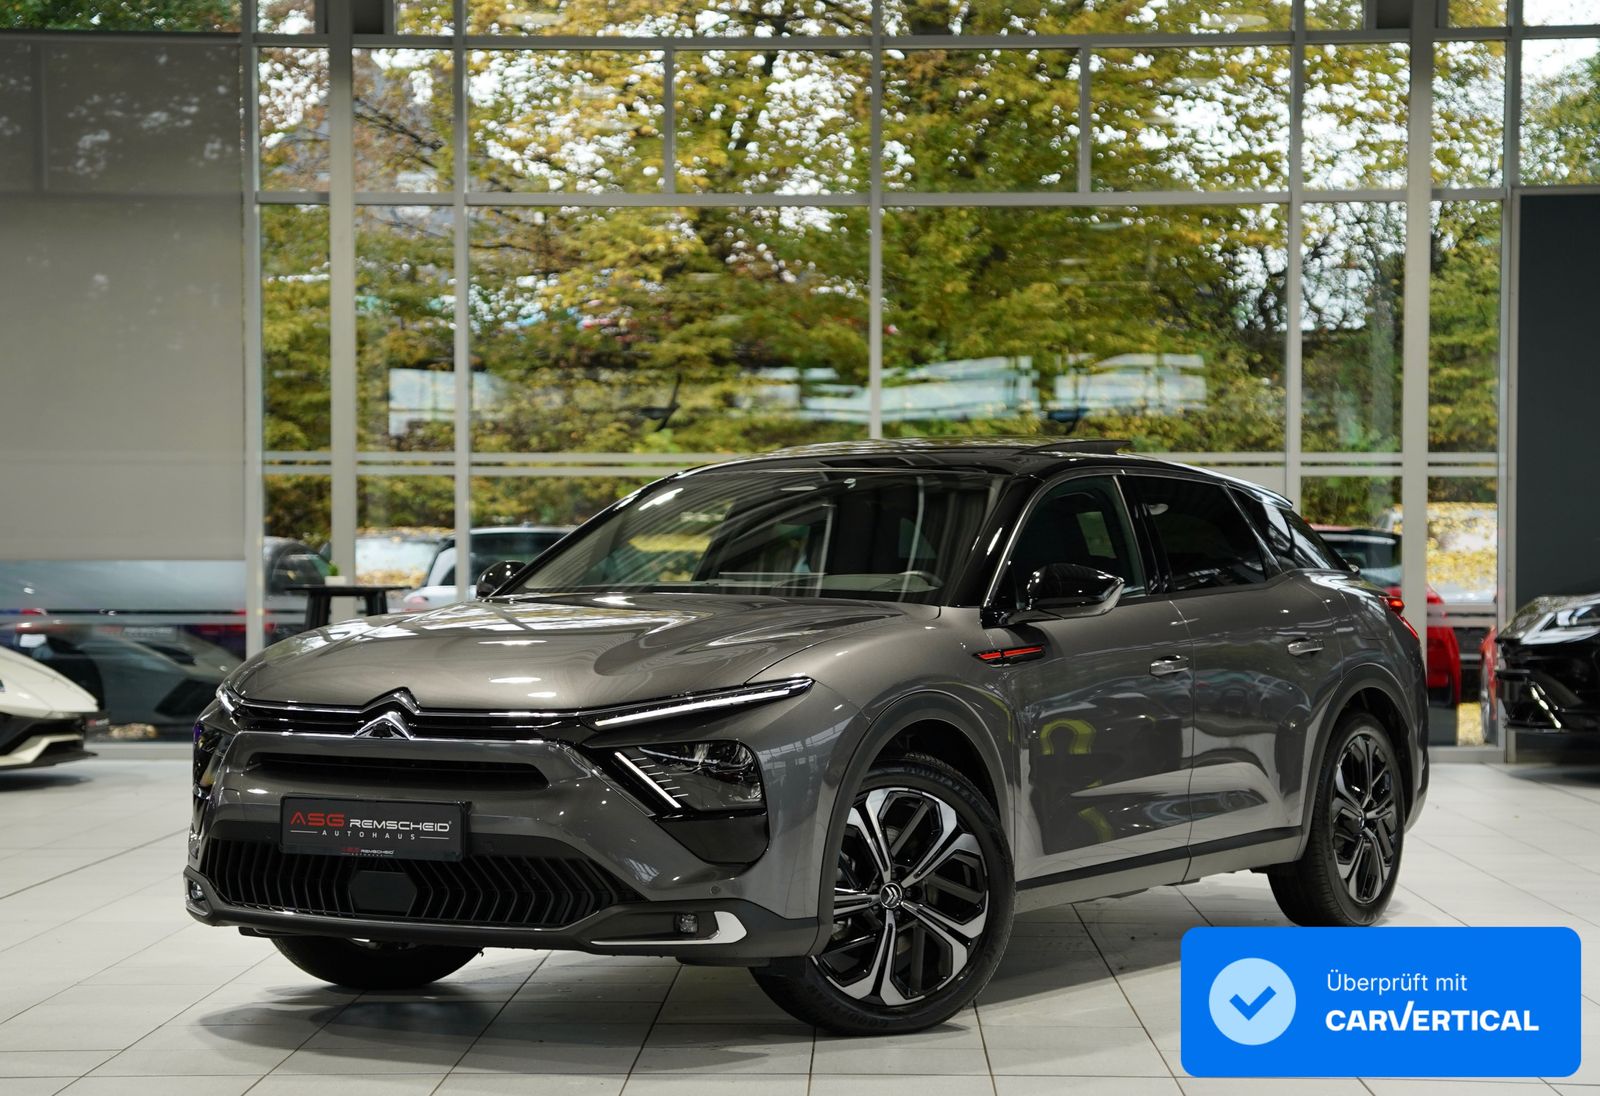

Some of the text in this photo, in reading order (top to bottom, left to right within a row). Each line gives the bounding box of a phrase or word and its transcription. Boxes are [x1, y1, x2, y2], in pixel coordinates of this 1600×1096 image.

[290, 812, 450, 832] ASG REMSCHEID
[321, 830, 416, 840] AUTOHAUS
